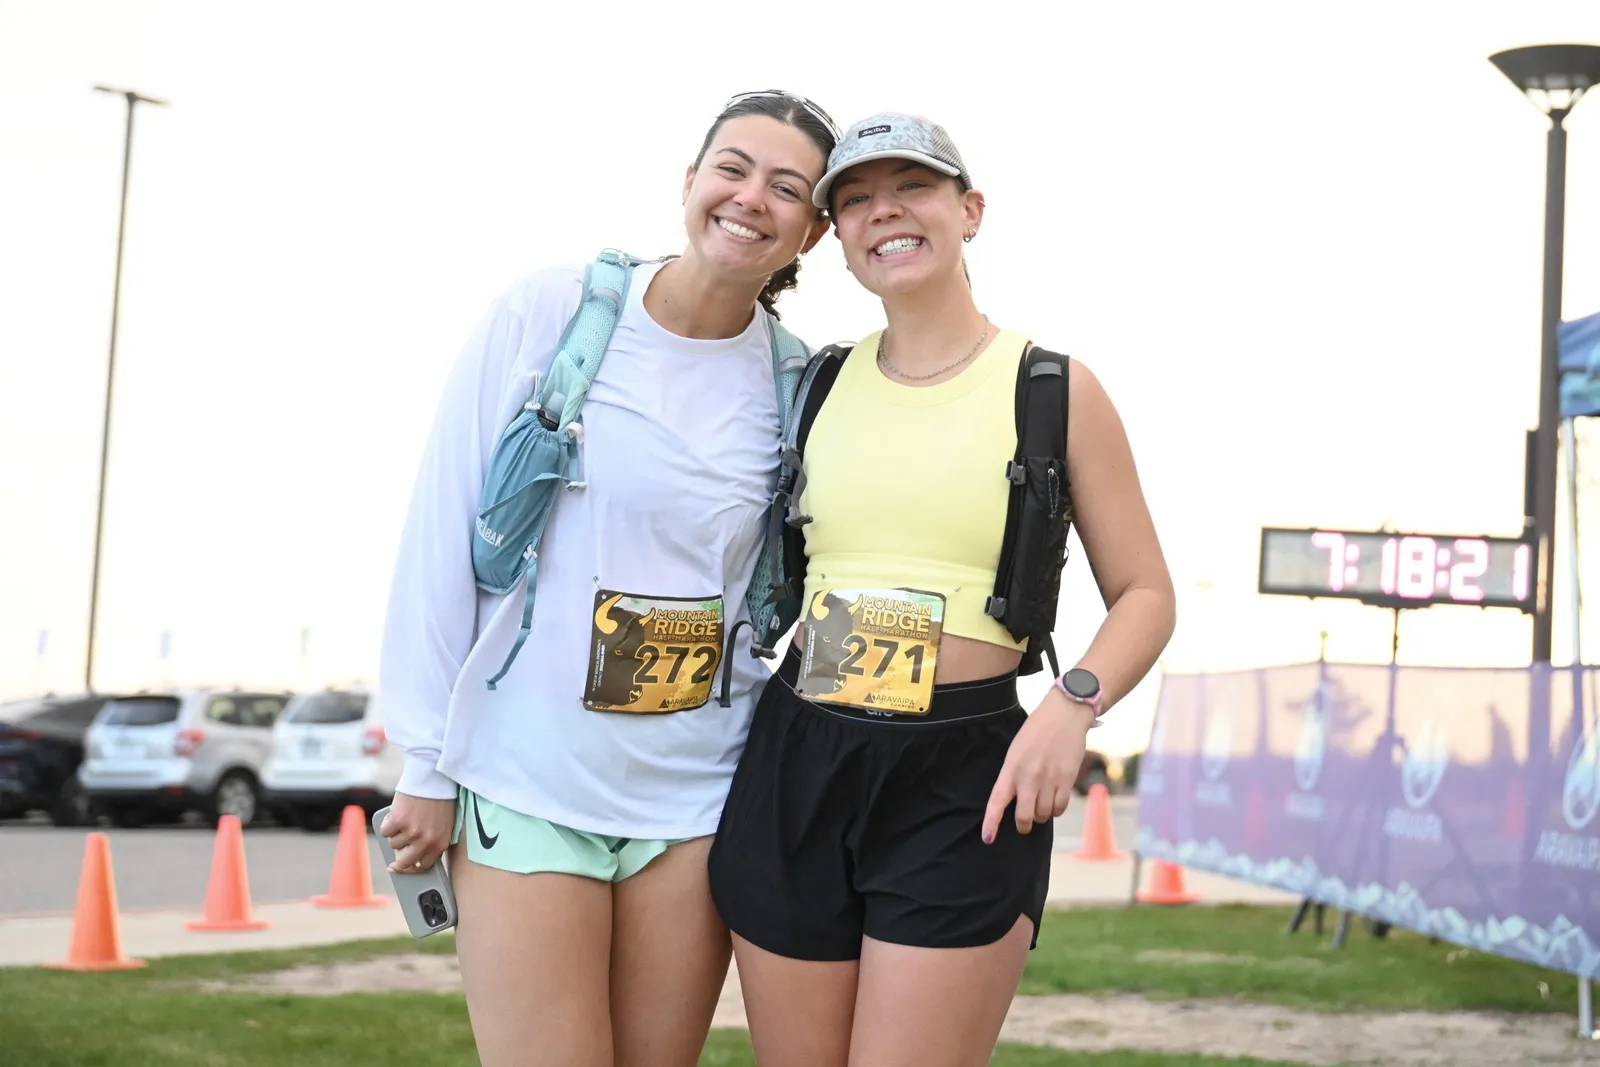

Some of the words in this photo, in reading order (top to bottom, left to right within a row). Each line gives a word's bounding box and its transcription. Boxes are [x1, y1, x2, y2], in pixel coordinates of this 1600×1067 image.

[1311, 531, 1531, 601] 7:18:21
[657, 609, 719, 621] MOUNTAIN
[864, 595, 932, 616] MOUNTAIN
[653, 619, 718, 637] RIDGE
[861, 607, 931, 633] RIDGE
[633, 644, 718, 686] 272
[838, 632, 925, 685] 271
